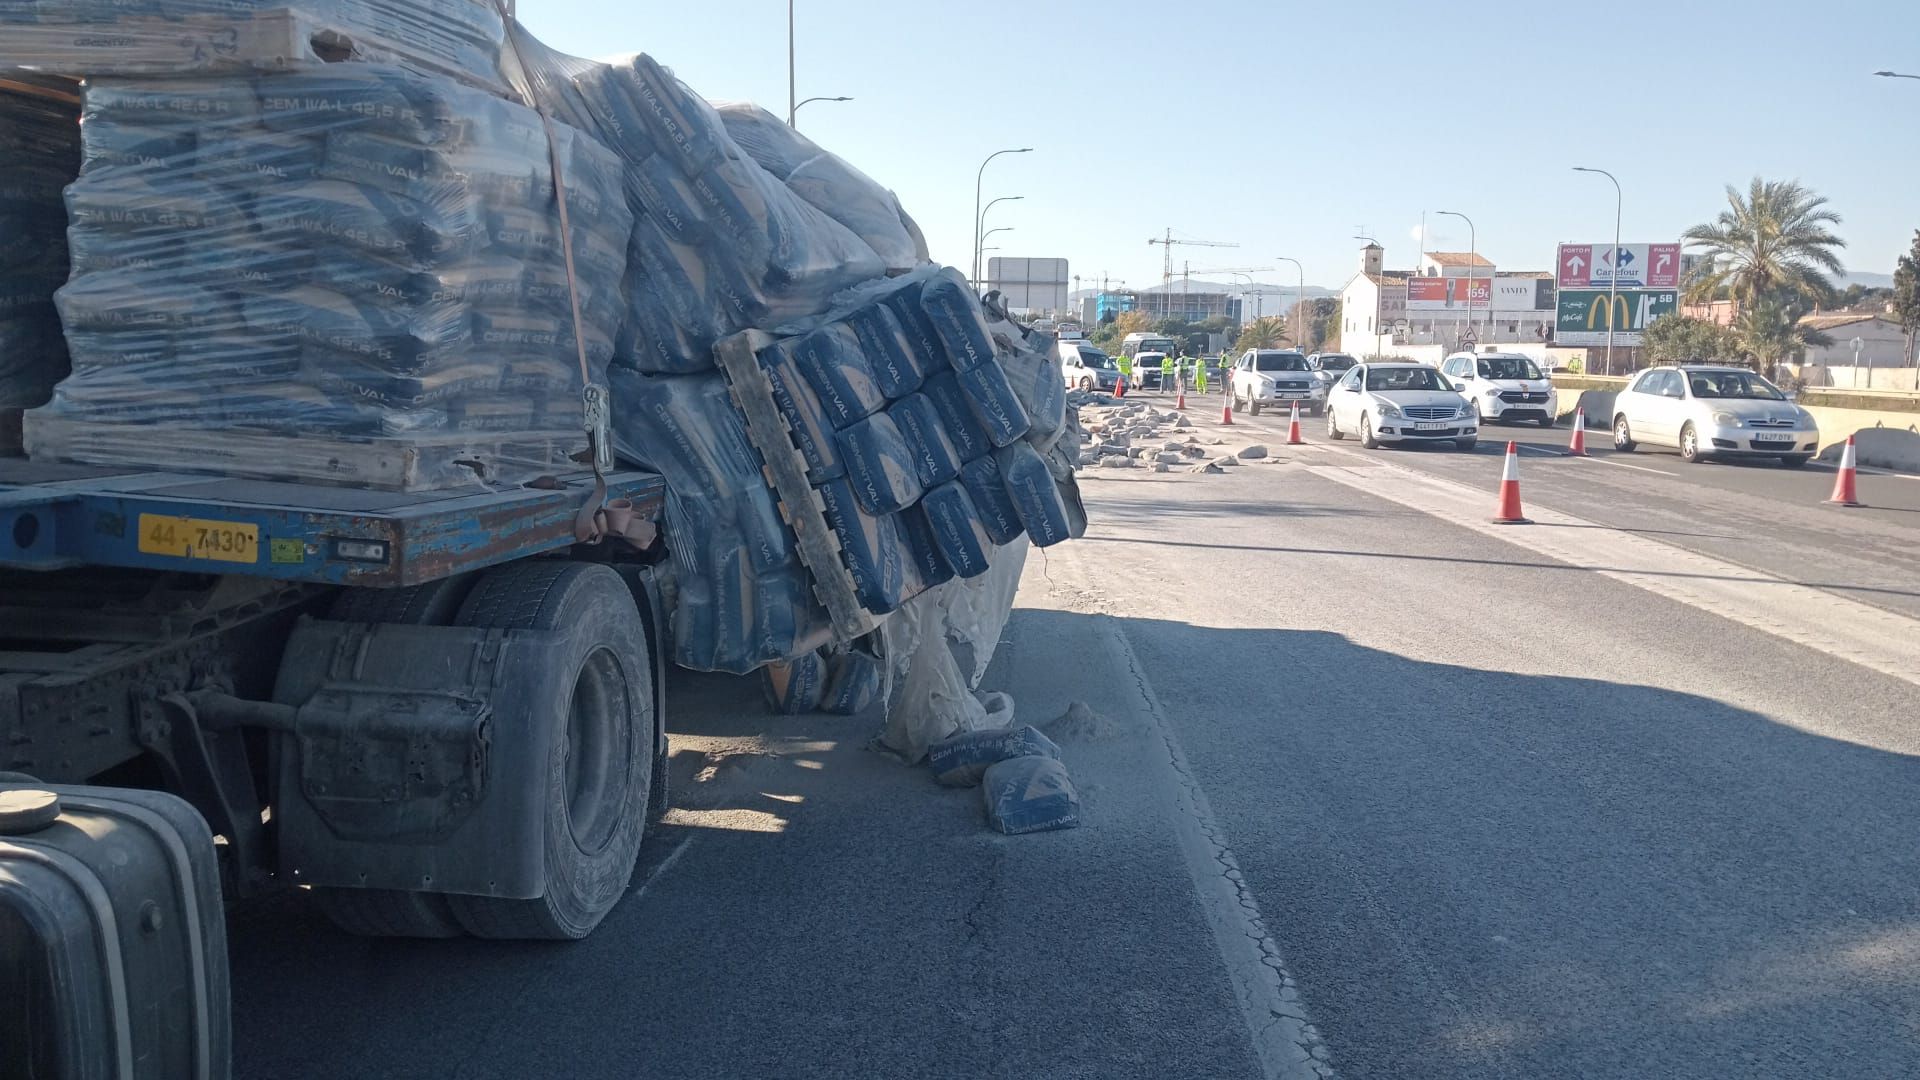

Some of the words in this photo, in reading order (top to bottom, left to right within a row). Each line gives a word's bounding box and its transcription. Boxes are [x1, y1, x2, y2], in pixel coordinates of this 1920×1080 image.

[808, 349, 849, 419] CEMENTVAL
[848, 433, 880, 506] CEMENTVAL
[150, 523, 176, 547] 44
